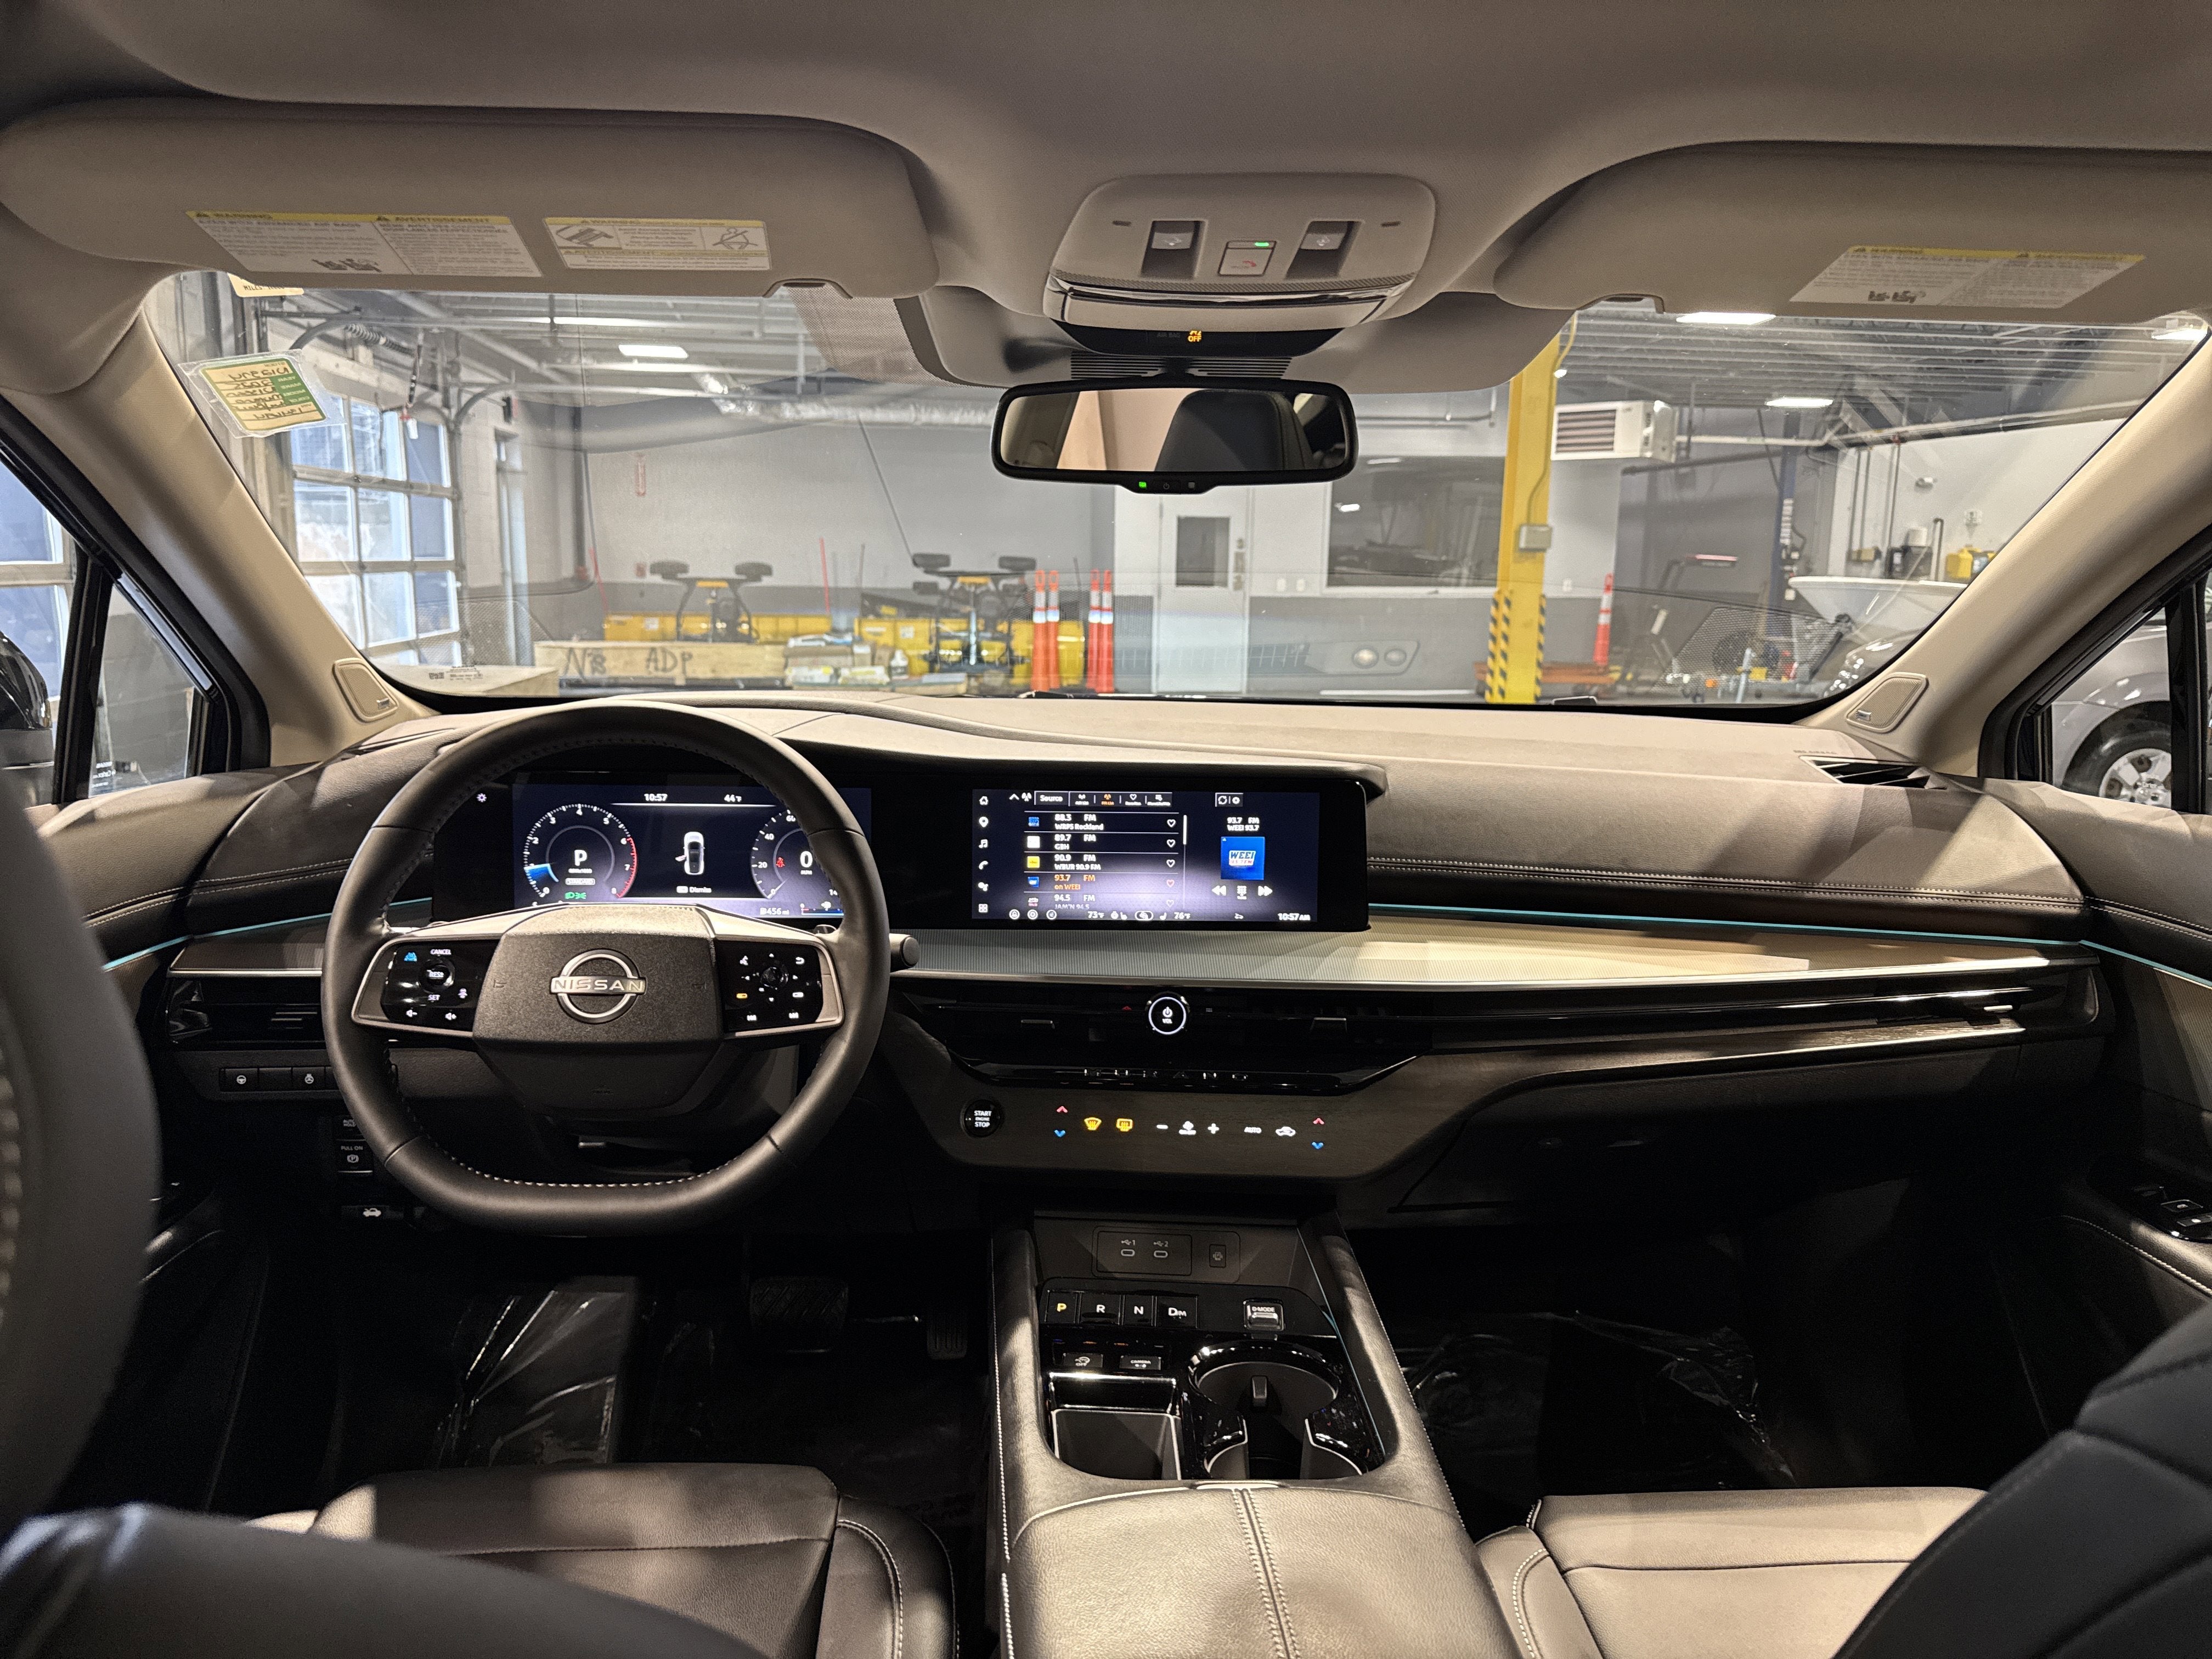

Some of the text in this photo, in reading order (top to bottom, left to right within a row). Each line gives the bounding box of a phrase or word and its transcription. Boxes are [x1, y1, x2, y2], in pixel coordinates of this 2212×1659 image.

[644, 793, 668, 802] 10:57
[574, 849, 588, 866] P
[800, 850, 813, 868] 0
[554, 979, 644, 991] NISSAN
[1057, 1303, 1067, 1312] P
[1096, 1305, 1105, 1313] R
[1133, 1306, 1144, 1314] N
